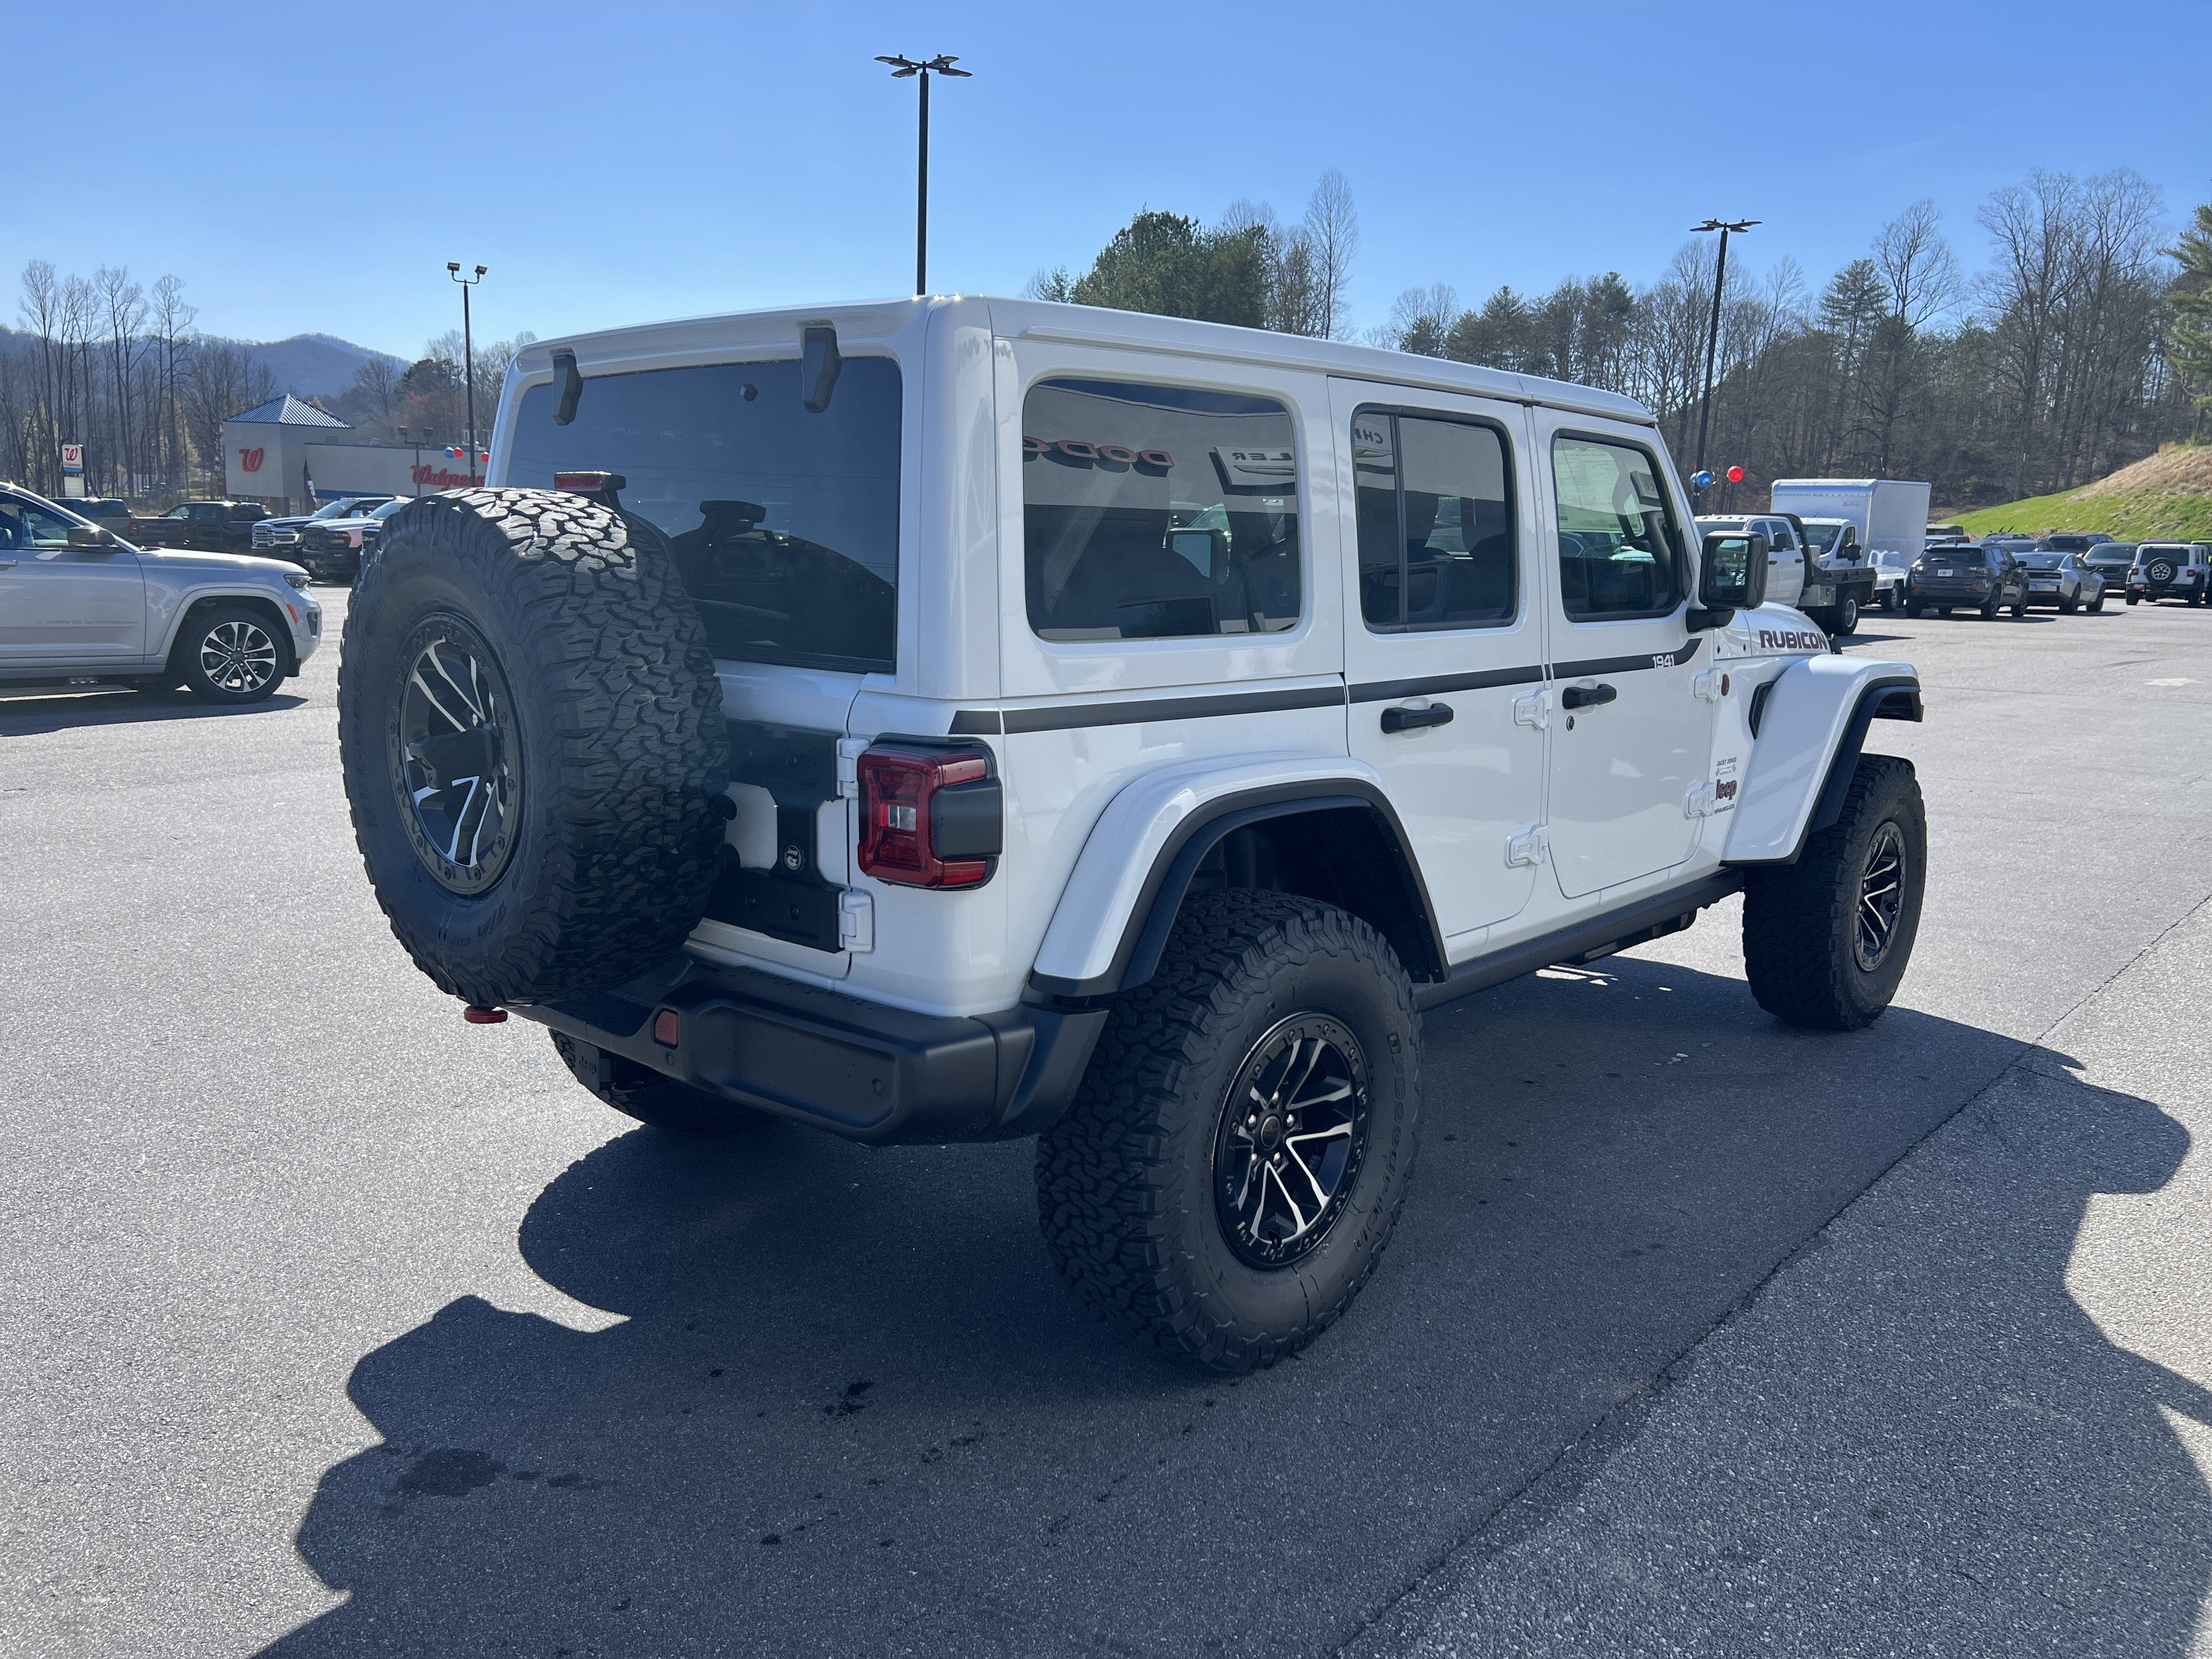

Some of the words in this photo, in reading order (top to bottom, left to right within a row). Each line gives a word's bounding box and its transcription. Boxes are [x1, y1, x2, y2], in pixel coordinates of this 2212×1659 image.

[65, 447, 78, 461] W
[239, 448, 263, 472] W
[1759, 630, 1828, 650] RUBICON
[1652, 654, 1674, 668] 1941
[1715, 779, 1737, 800] Jeep
[578, 1056, 596, 1075] Jeep
